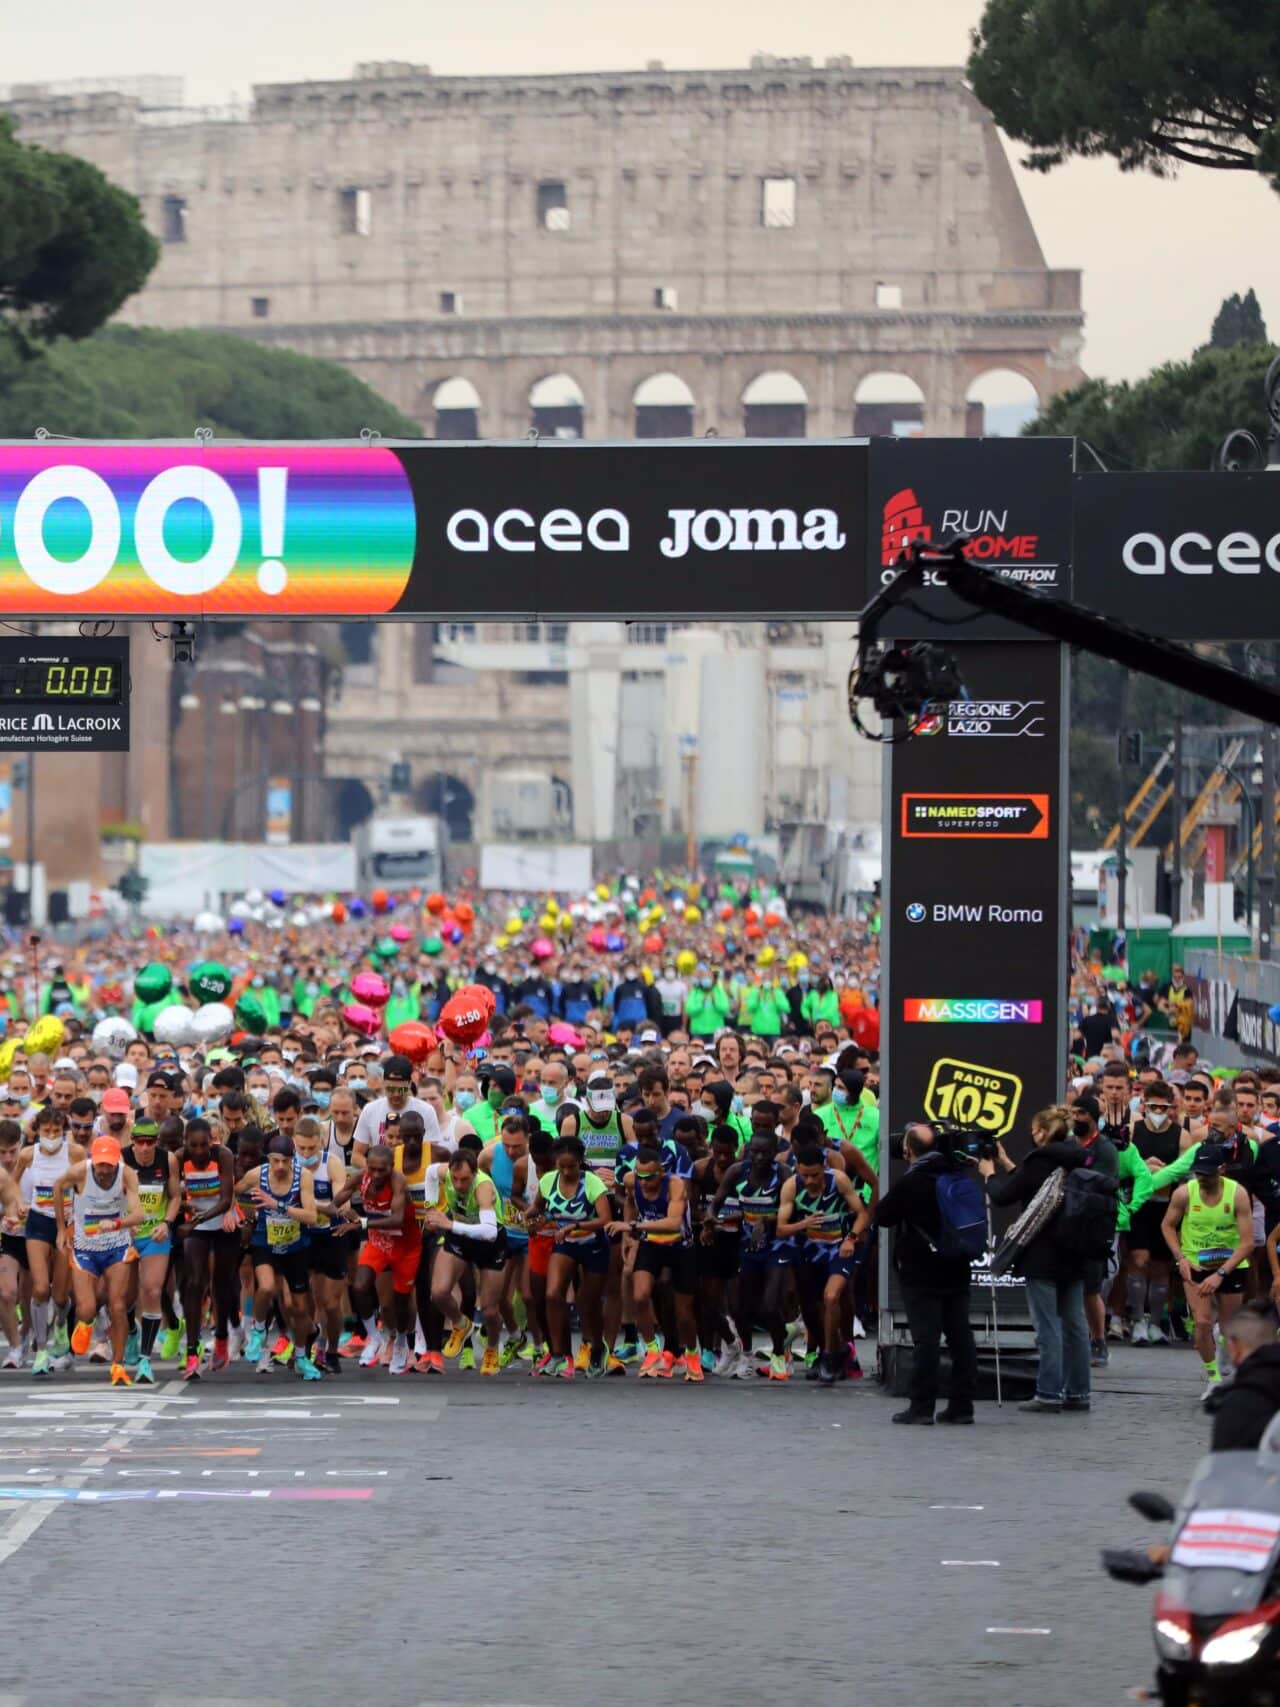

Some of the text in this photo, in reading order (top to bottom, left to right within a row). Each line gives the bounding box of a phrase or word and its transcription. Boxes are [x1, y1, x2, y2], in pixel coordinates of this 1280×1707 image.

[447, 508, 630, 552] acea
[941, 510, 1008, 533] RUN
[948, 704, 1011, 717] REGIONE
[58, 715, 121, 730] LACROIX
[948, 720, 991, 733] LAZIO
[70, 734, 93, 742] Suisse
[933, 905, 1043, 922] BMW Roma
[200, 977, 225, 994] 3:20
[455, 1009, 481, 1027] 2:50
[918, 1002, 1028, 1020] MASSIGEN
[953, 1070, 1001, 1091] RADIO
[935, 1082, 1008, 1130] 105
[582, 1132, 618, 1141] Vicenza
